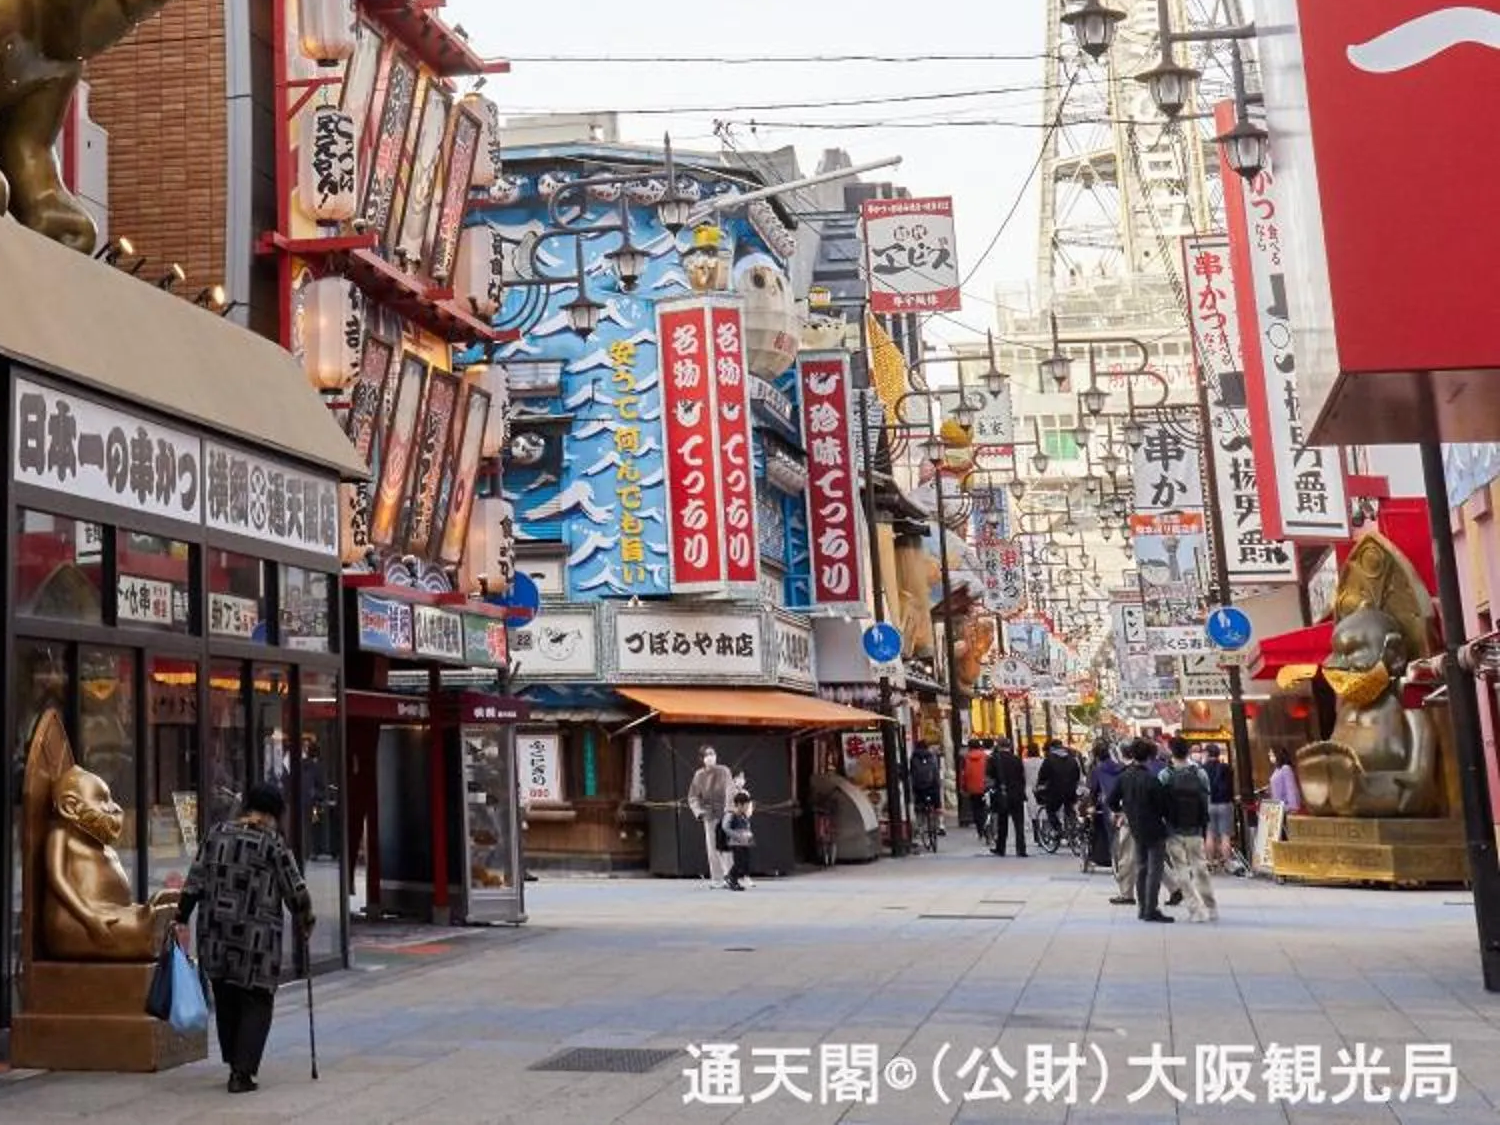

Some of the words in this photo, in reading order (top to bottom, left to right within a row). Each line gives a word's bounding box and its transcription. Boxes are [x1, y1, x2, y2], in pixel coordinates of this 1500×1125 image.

[18, 391, 197, 511] 日本一の串かつ
[1144, 430, 1188, 516] 串か
